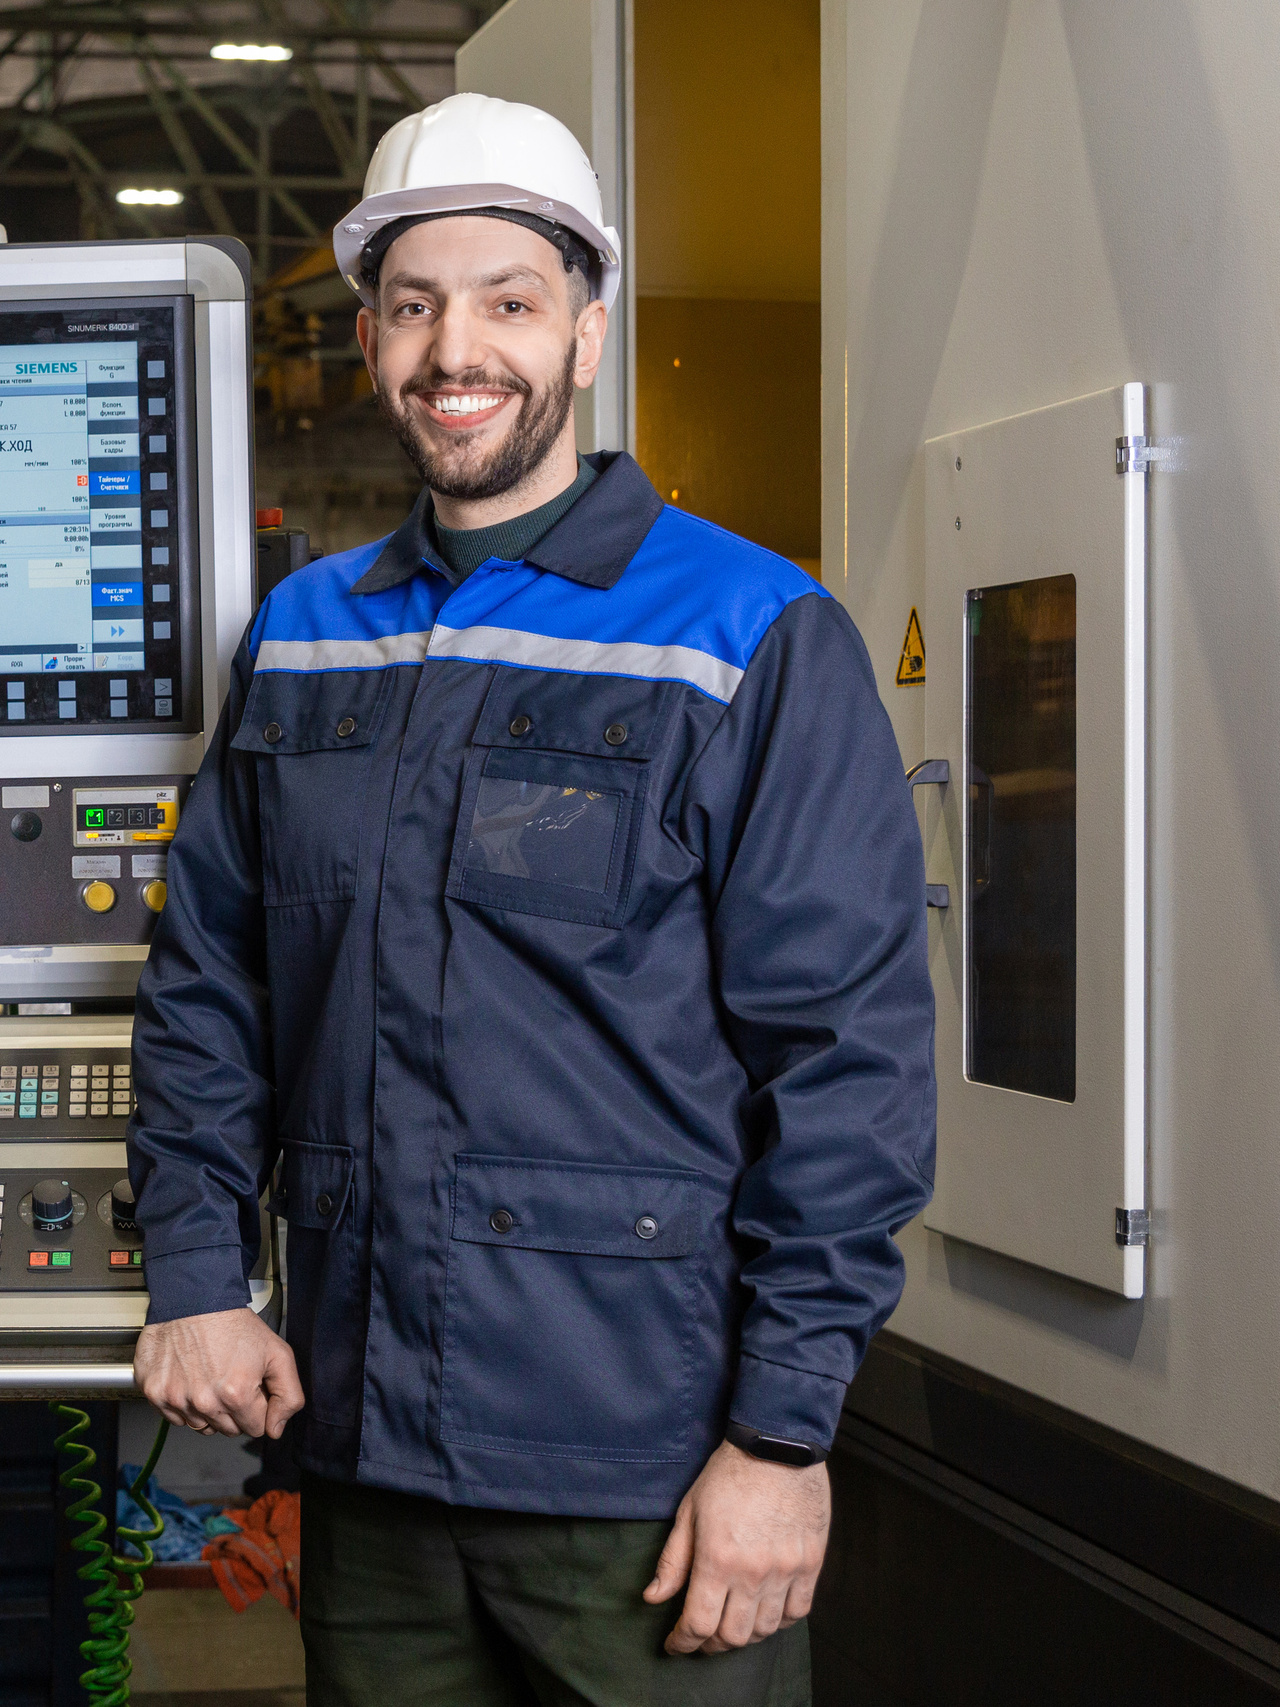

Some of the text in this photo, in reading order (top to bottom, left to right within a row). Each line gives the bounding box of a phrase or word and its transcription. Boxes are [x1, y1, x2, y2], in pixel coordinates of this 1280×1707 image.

[68, 324, 107, 333] SINUMERIK
[108, 323, 128, 331] 840D
[15, 362, 77, 374] SIEMENS
[98, 364, 125, 372] Функции
[100, 409, 125, 417] функции
[104, 447, 123, 455] кадры
[98, 476, 124, 484] Таймеры
[100, 483, 129, 491] Счетчики
[110, 594, 124, 602] MCS
[96, 813, 101, 822] 1
[116, 812, 122, 821] 2
[136, 812, 143, 821] 3
[157, 811, 163, 821] 4
